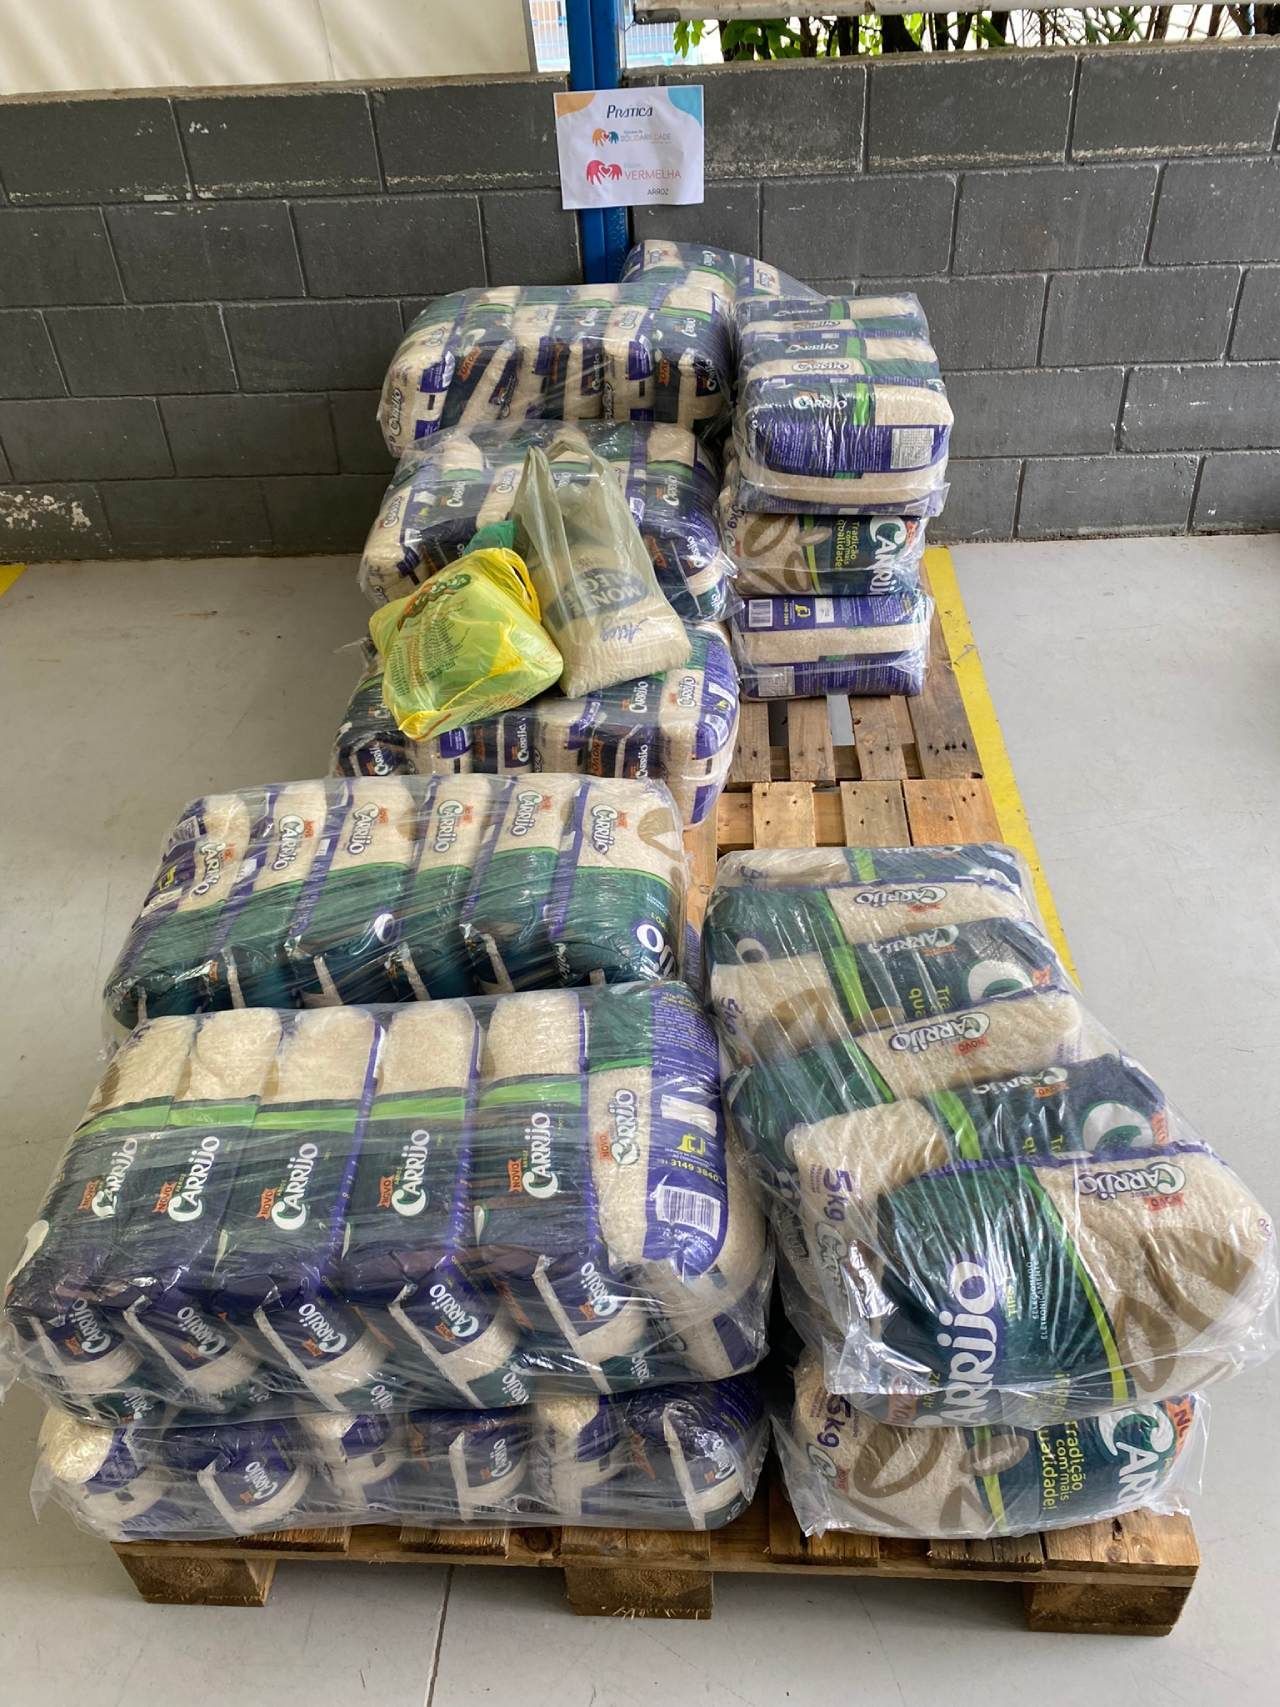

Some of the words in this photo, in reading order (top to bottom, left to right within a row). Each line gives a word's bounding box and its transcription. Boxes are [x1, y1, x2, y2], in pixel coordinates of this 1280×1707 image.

[624, 169, 682, 181] VERMELHA
[629, 681, 648, 713] CARRIJO
[677, 676, 696, 707] CARRIJO
[349, 802, 379, 855] CARRIJO
[434, 800, 463, 852] CARRIJO
[510, 790, 543, 836] CARRIJO
[591, 804, 618, 855] CARRIJO
[193, 842, 226, 895] CARRIJO
[272, 815, 305, 870] CARRIJO
[854, 886, 947, 907] CARRIJO
[888, 1011, 991, 1054] CARRIJO
[609, 1088, 640, 1166] CARRIJO
[91, 1137, 138, 1218] CARRIJO
[168, 1136, 220, 1221] CARRIJO
[391, 1129, 430, 1216] CARRIJO
[512, 1163, 521, 1190] NOVO
[522, 1112, 559, 1199] CARRIJO
[1073, 1162, 1187, 1201] CARRIJO
[157, 1183, 175, 1212] NOVO
[260, 1190, 275, 1217] NOVO
[271, 1143, 318, 1230] CARRIJO
[381, 1178, 393, 1206] NOVO
[823, 1168, 853, 1221] 5kg
[70, 1298, 111, 1354] CARRIJO
[177, 1306, 226, 1355] CARRIJO
[298, 1303, 348, 1353] CARRIJO
[429, 1284, 479, 1338] CARRIJO
[914, 1260, 997, 1427] ARRIJO
[816, 1394, 851, 1447] 5kg
